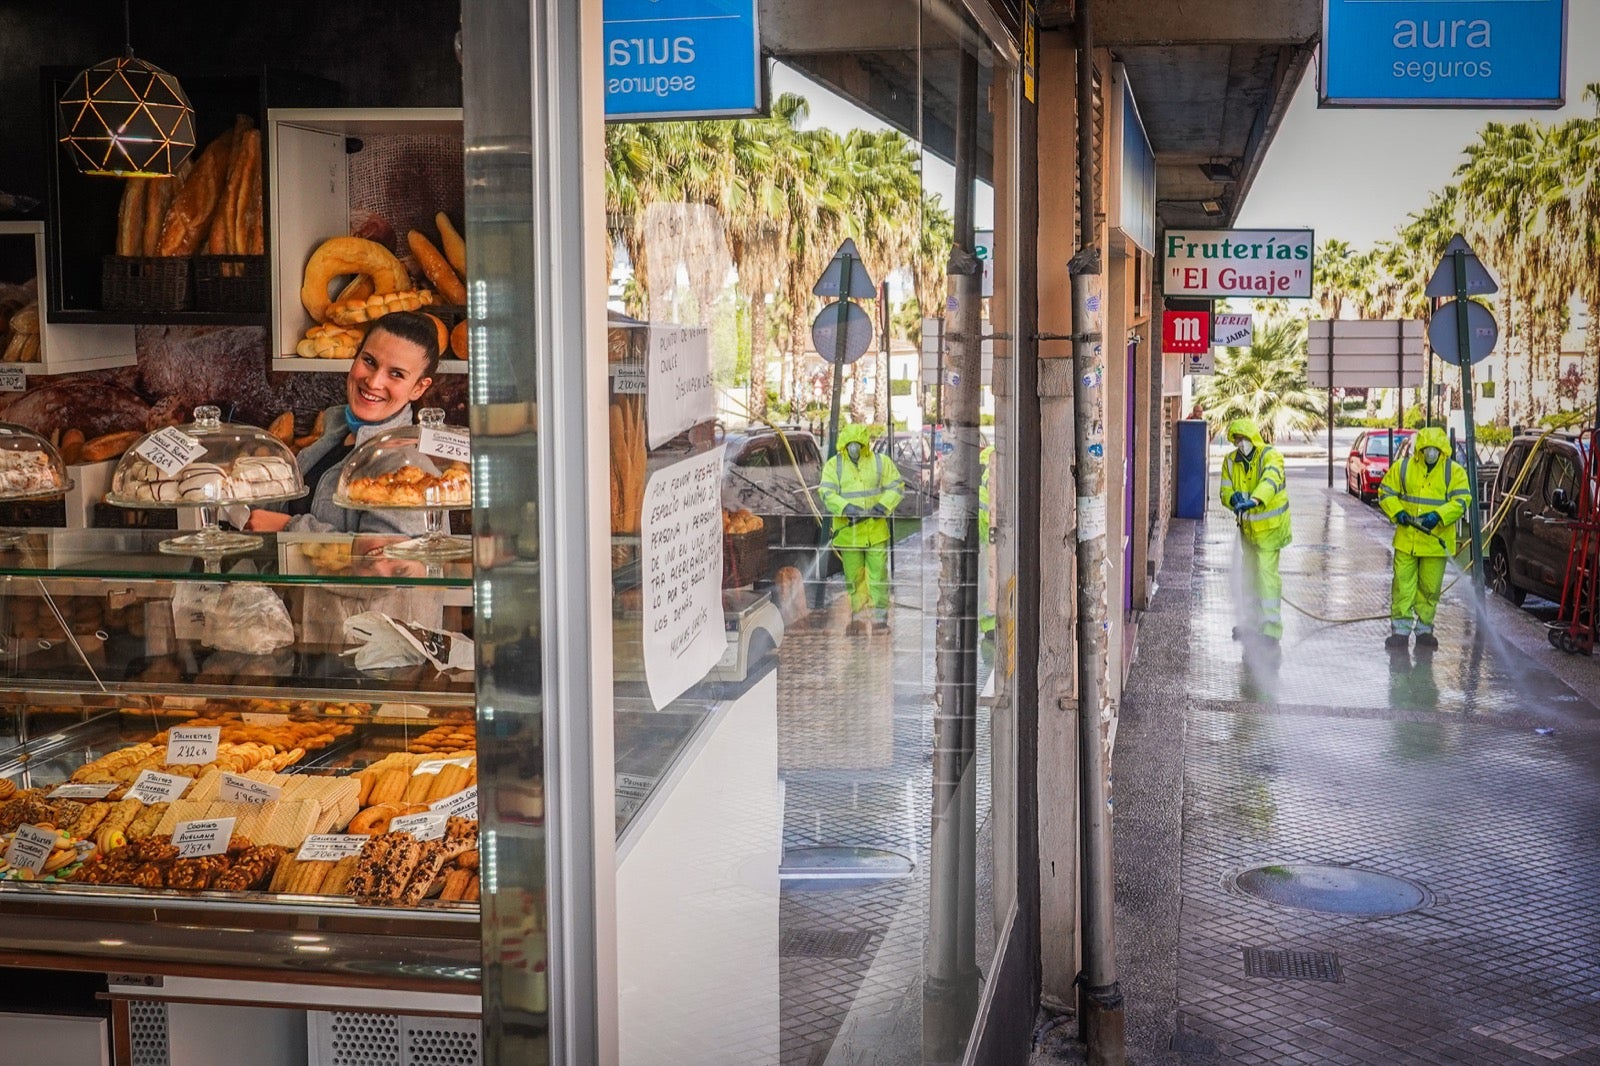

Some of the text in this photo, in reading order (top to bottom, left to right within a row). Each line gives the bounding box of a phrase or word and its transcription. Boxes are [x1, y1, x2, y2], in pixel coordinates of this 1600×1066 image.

[1392, 18, 1491, 49] aura
[1392, 60, 1492, 83] seguros
[1167, 235, 1309, 260] Fruterías
[1215, 316, 1249, 325] LERIA
[1226, 328, 1250, 344] JAIRA
[651, 522, 679, 550] PERSONA
[652, 595, 661, 609] LO
[654, 614, 667, 633] LOS
[180, 832, 215, 841] AVELLANA
